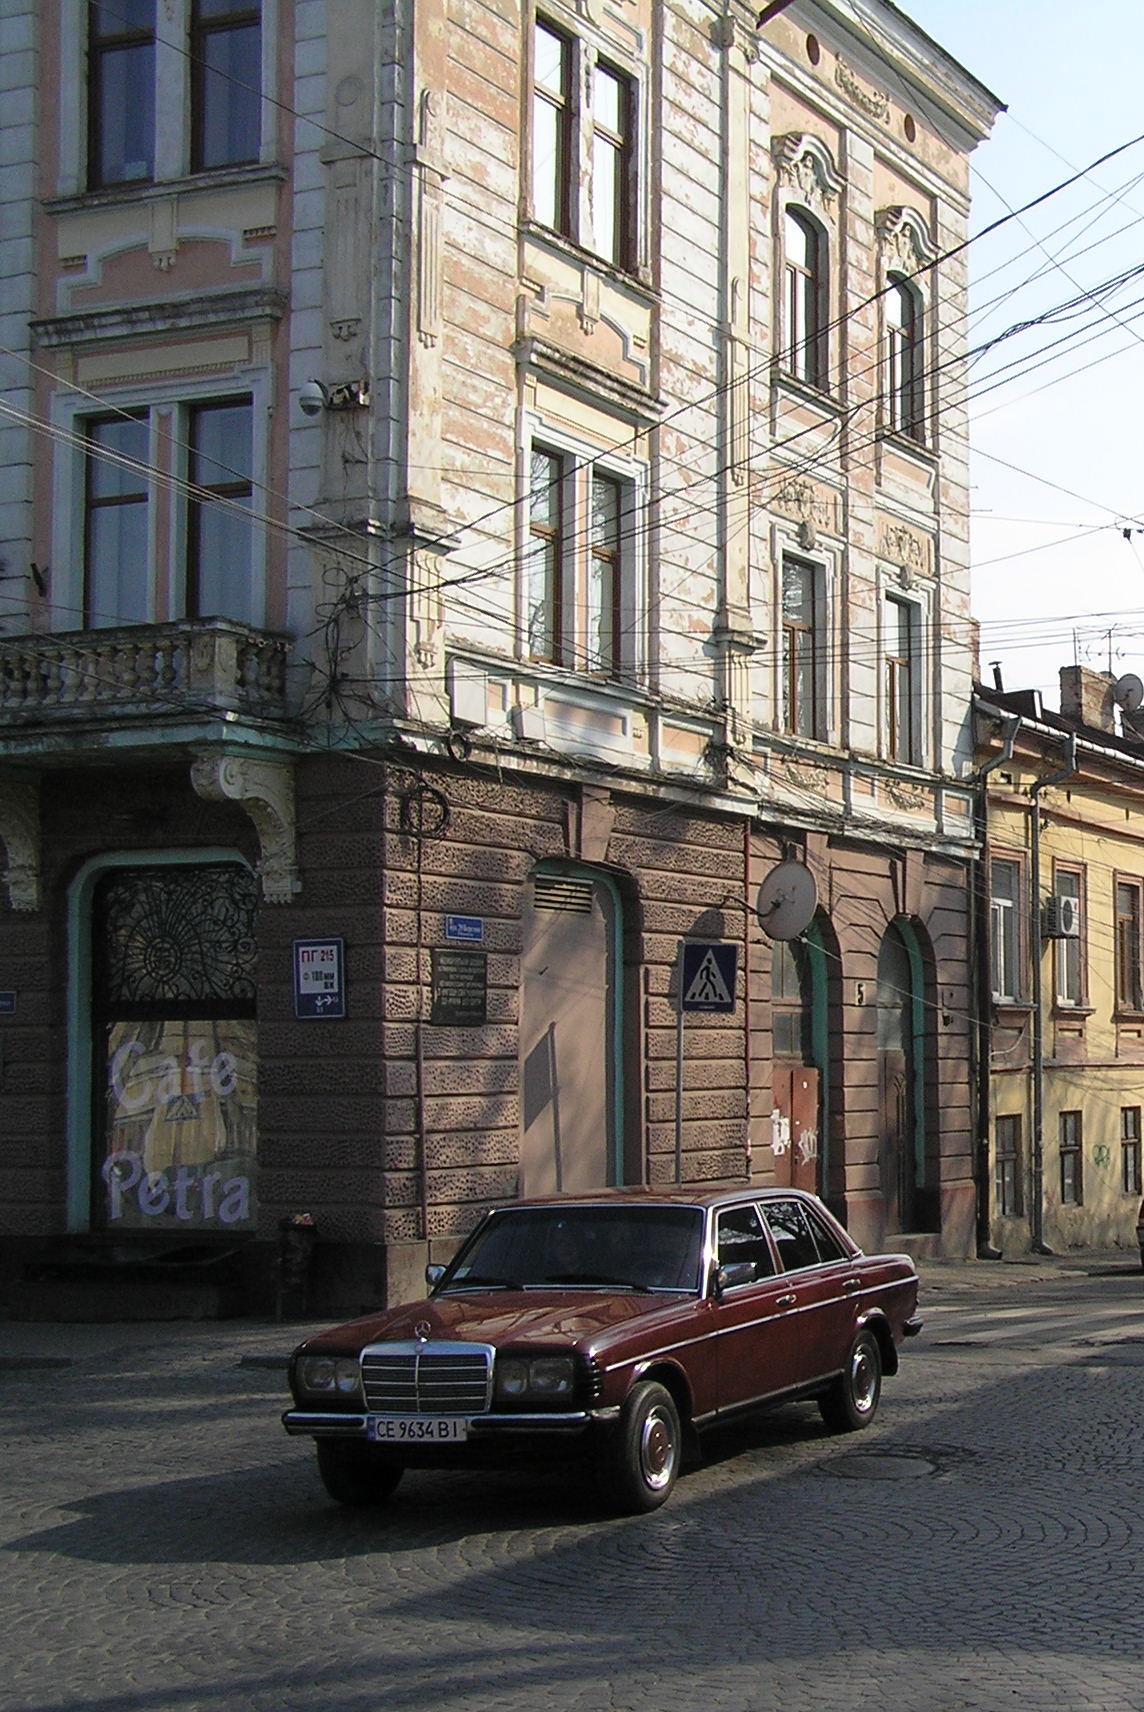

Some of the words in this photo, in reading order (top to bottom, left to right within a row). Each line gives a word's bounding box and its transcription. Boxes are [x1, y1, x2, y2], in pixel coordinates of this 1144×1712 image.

[301, 949, 319, 963] ПГ
[320, 949, 334, 962] 215
[857, 983, 864, 1005] 5
[112, 1038, 238, 1109] Cafe
[101, 1150, 250, 1223] Petra
[377, 1421, 395, 1438] CE
[399, 1421, 434, 1438] 9634
[438, 1421, 457, 1438] BI
